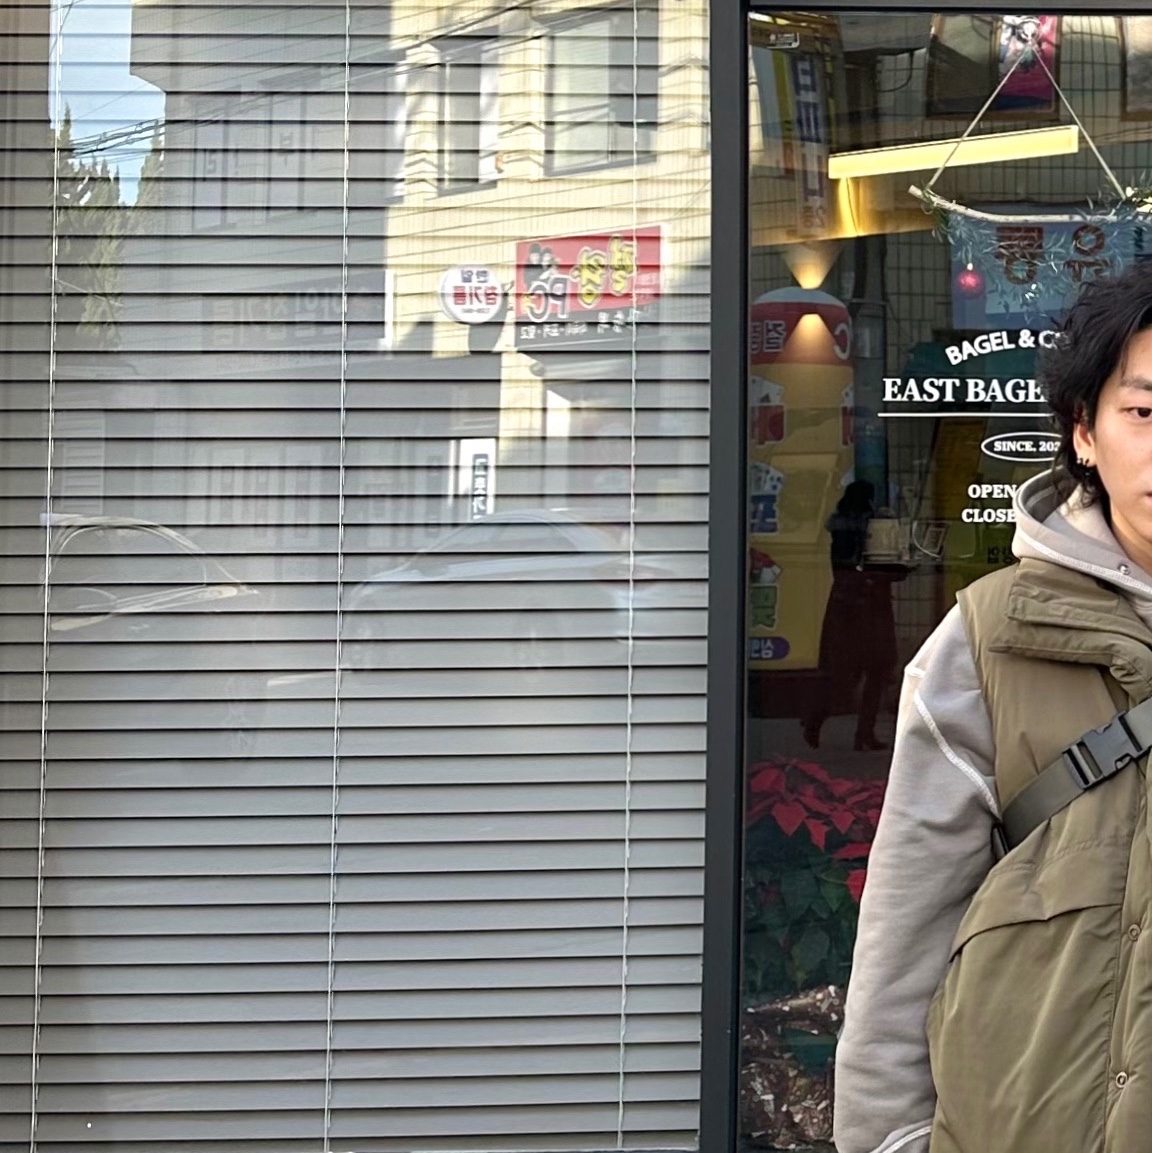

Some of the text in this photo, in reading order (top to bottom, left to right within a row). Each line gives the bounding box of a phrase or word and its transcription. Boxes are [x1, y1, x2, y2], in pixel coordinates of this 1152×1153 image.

[945, 330, 1016, 366] BAGEL
[1018, 329, 1036, 348] &
[882, 378, 960, 402] EAST
[967, 484, 1018, 499] OPEN
